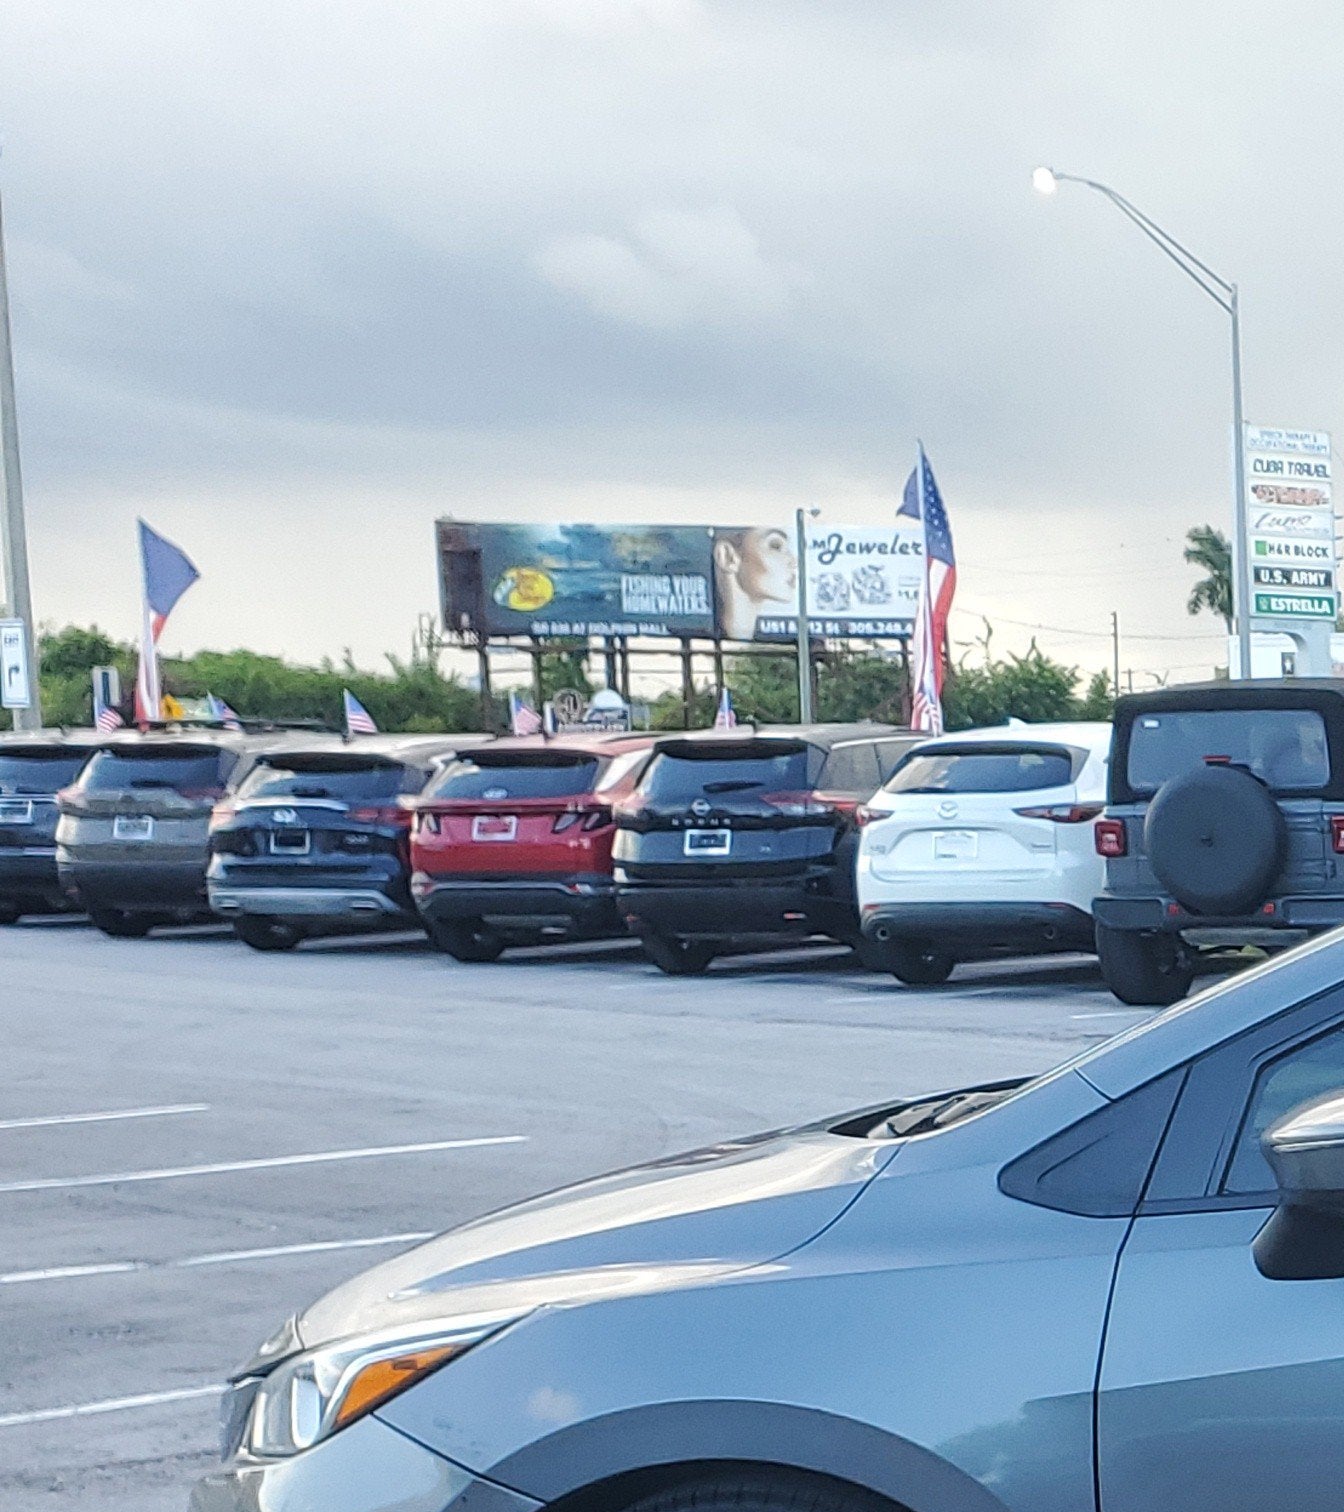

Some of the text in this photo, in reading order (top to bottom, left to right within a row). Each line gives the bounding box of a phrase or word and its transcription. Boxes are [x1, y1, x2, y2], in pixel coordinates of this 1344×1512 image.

[1253, 458, 1330, 478] CUBA TRAVEL
[817, 532, 923, 565] Jeweler
[1294, 545, 1329, 558] BLOCK
[1260, 569, 1326, 586] U.S. ARMY
[1270, 597, 1332, 614] ESTRELLA
